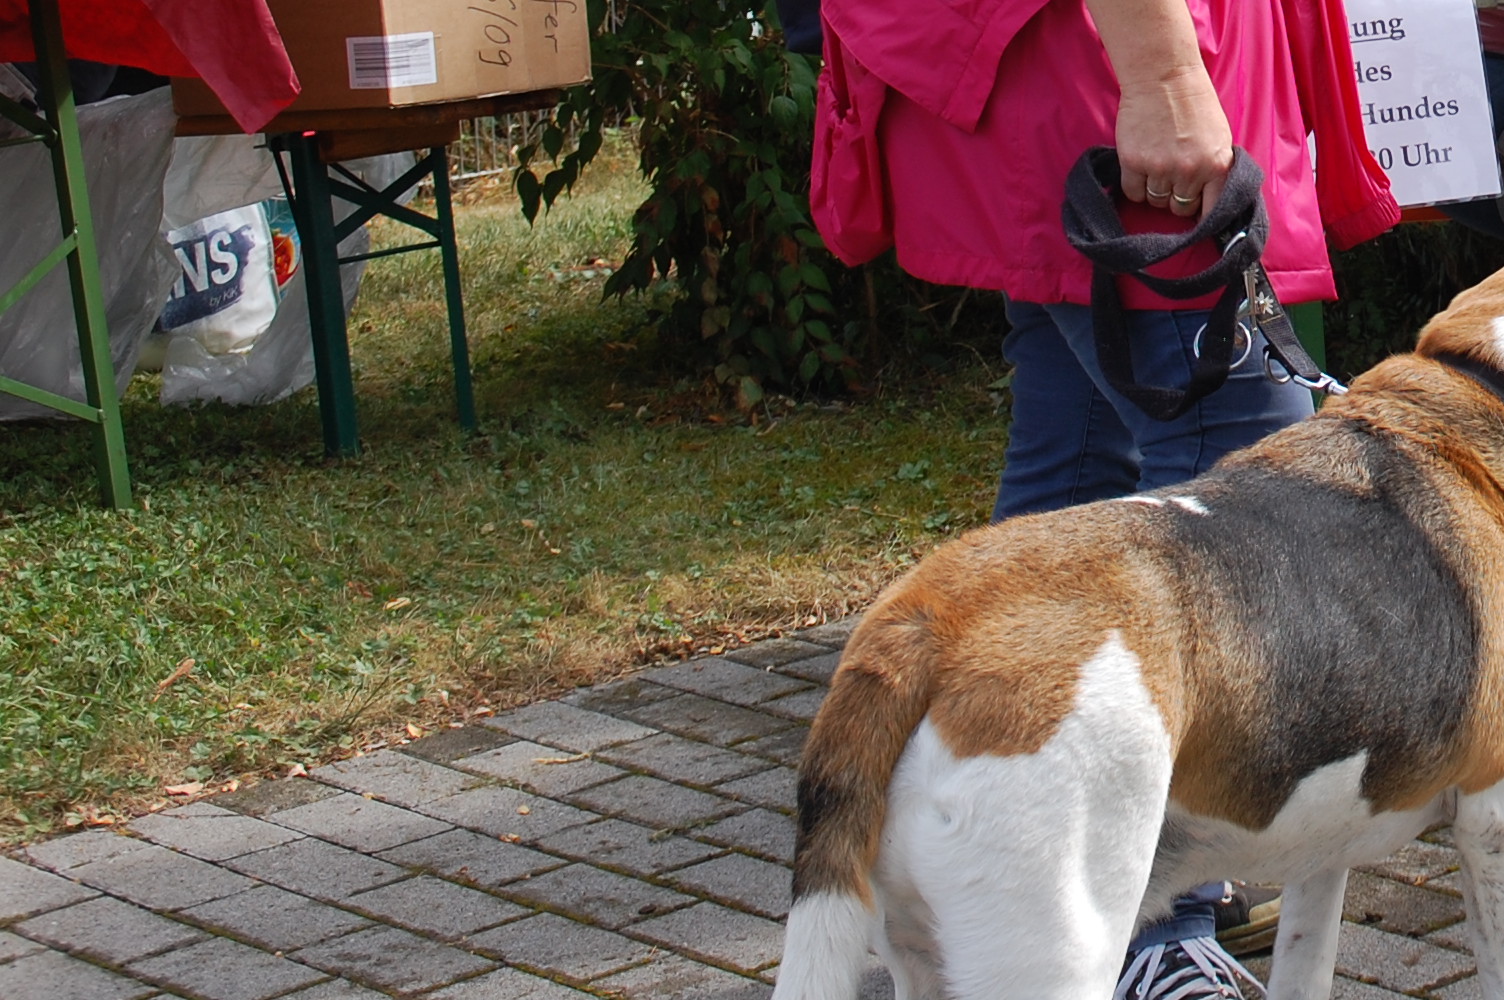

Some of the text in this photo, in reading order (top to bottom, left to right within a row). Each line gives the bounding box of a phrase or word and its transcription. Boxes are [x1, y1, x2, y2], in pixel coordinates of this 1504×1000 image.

[1350, 17, 1406, 41] ung
[1369, 142, 1453, 171] 0 Uhr
[172, 231, 239, 299] NS
[209, 295, 221, 307] by
